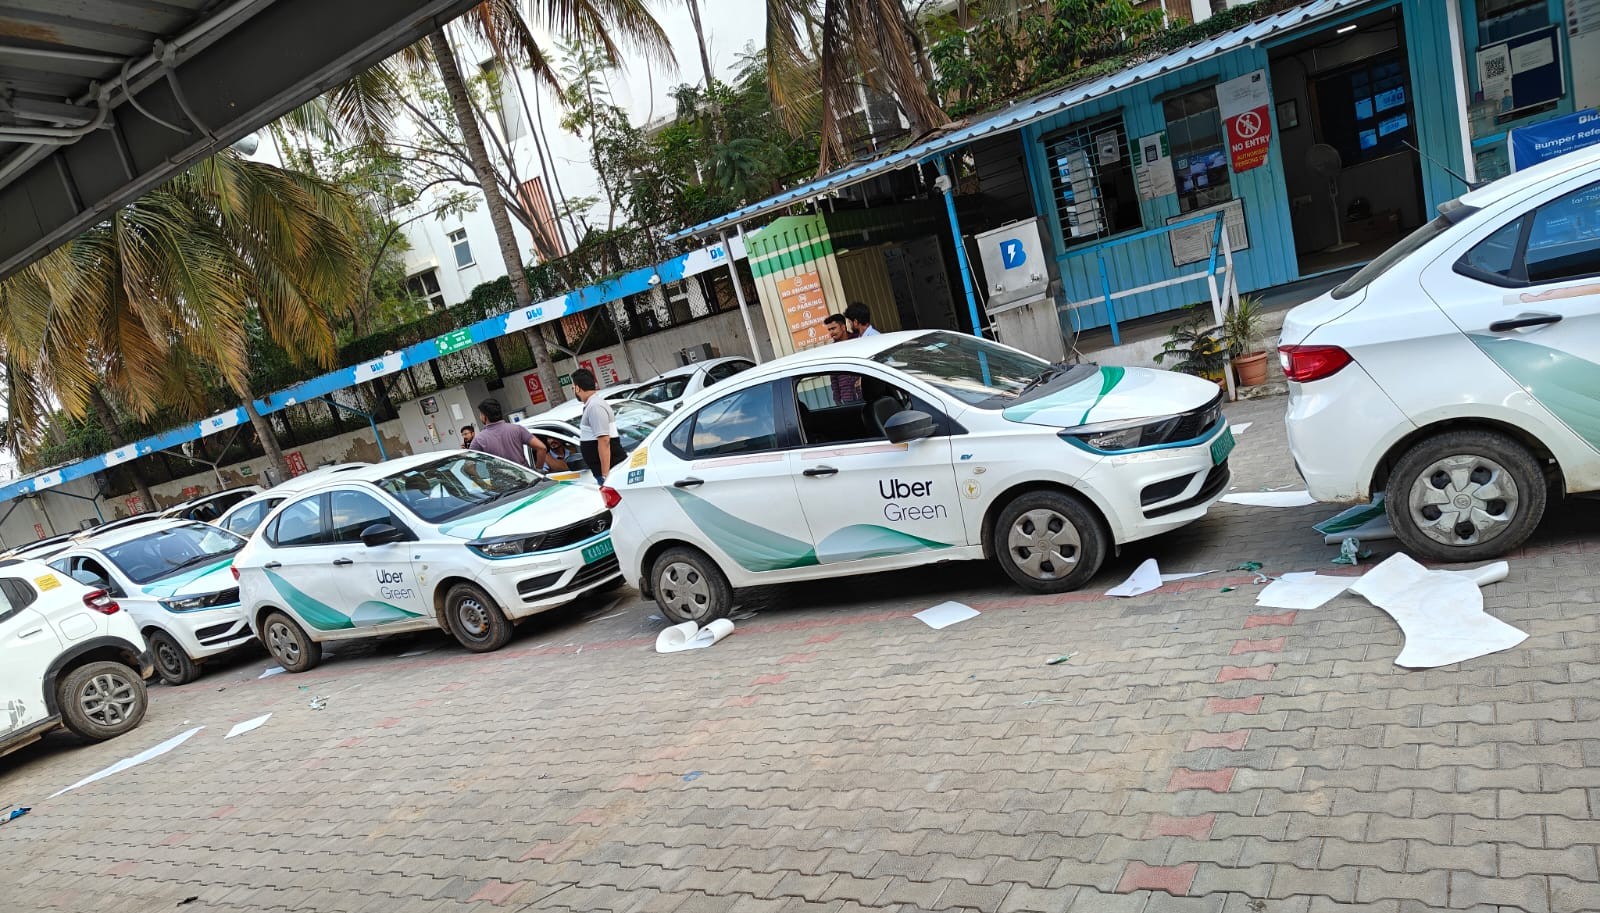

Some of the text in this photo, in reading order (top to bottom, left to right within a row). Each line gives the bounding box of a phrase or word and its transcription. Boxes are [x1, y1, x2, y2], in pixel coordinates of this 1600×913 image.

[1579, 113, 1600, 124] Blu
[1232, 134, 1270, 153] NO ENTRY
[1535, 135, 1576, 151] Bumper
[782, 290, 791, 298] NO
[879, 479, 932, 499] Uber
[884, 503, 947, 521] Green
[376, 569, 403, 584] Uber
[381, 586, 416, 599] Green
